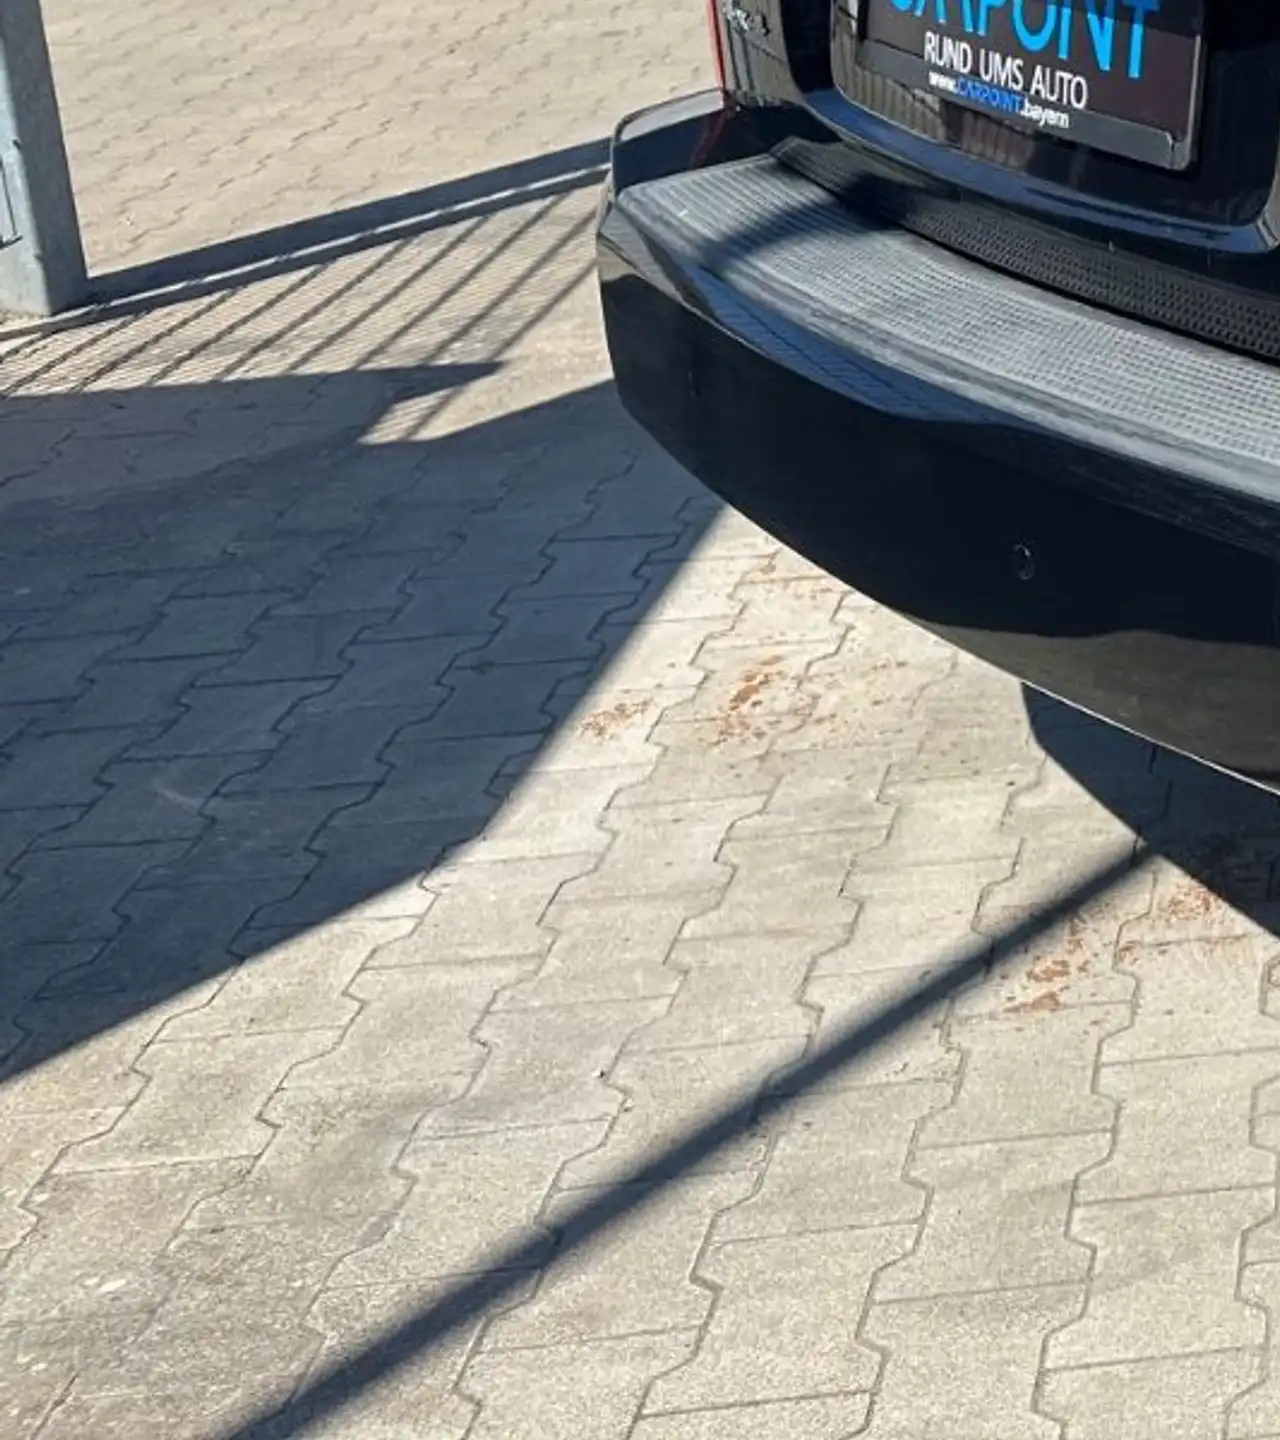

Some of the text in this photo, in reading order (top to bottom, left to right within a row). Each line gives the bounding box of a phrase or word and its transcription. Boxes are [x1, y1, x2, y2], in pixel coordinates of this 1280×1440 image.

[924, 30, 1088, 109] RUND UMS AUTO
